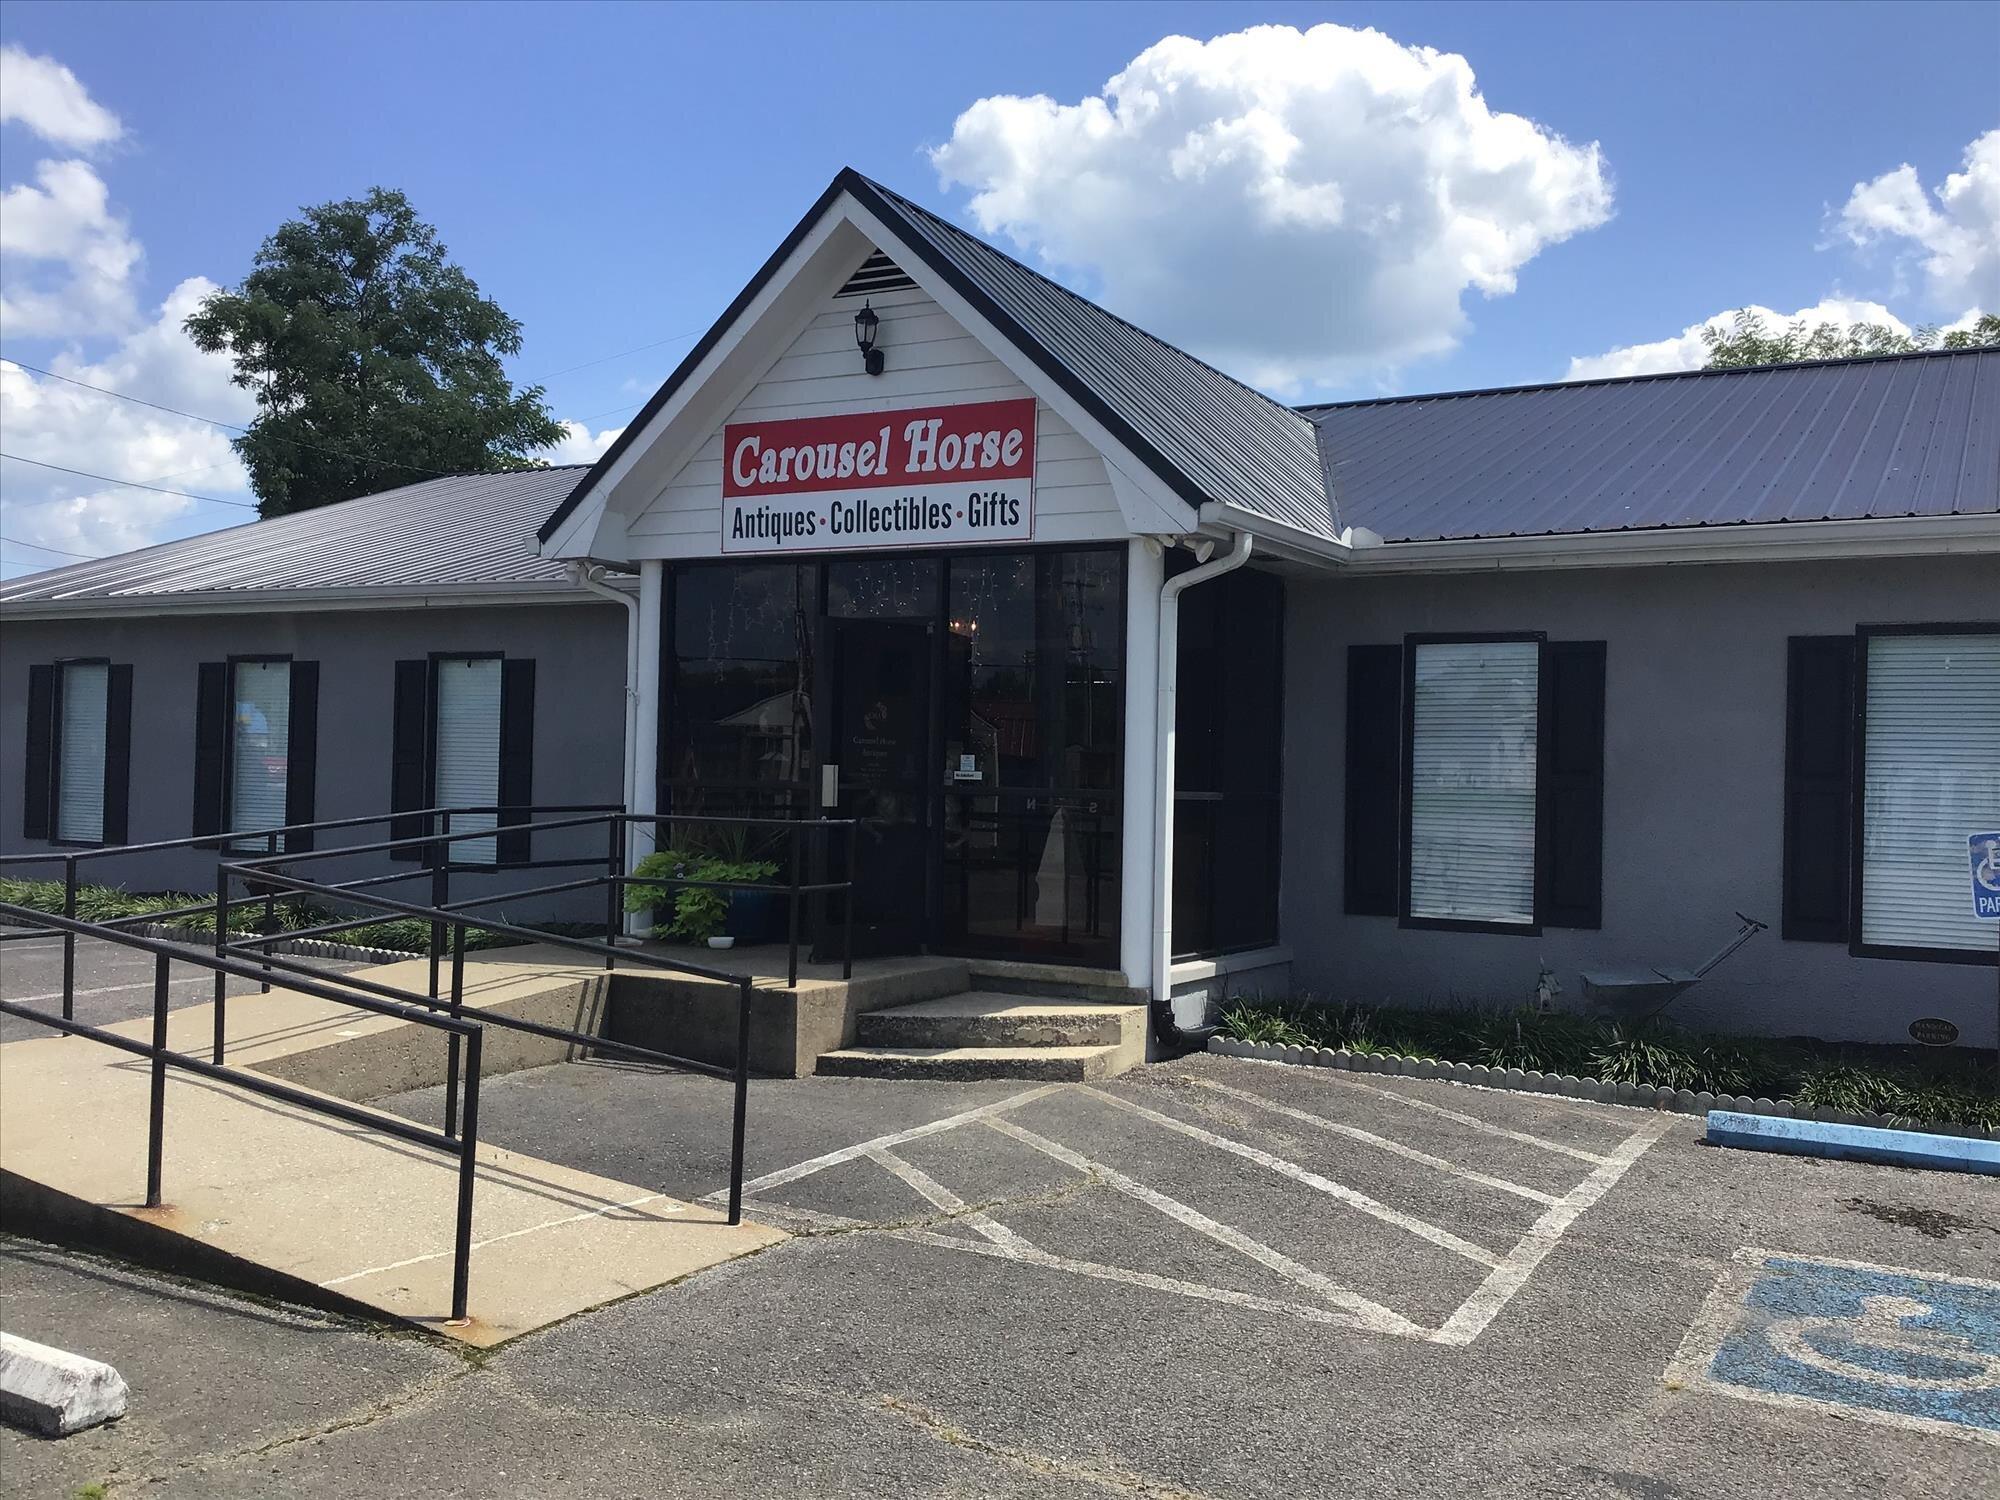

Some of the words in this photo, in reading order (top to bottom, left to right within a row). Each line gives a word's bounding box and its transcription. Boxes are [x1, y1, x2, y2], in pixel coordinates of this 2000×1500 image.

[731, 425, 891, 488] Carousel
[903, 418, 1023, 473] Horse
[732, 506, 817, 545] Antiques
[830, 495, 952, 535] Collectibles
[967, 491, 1021, 528] Gifts
